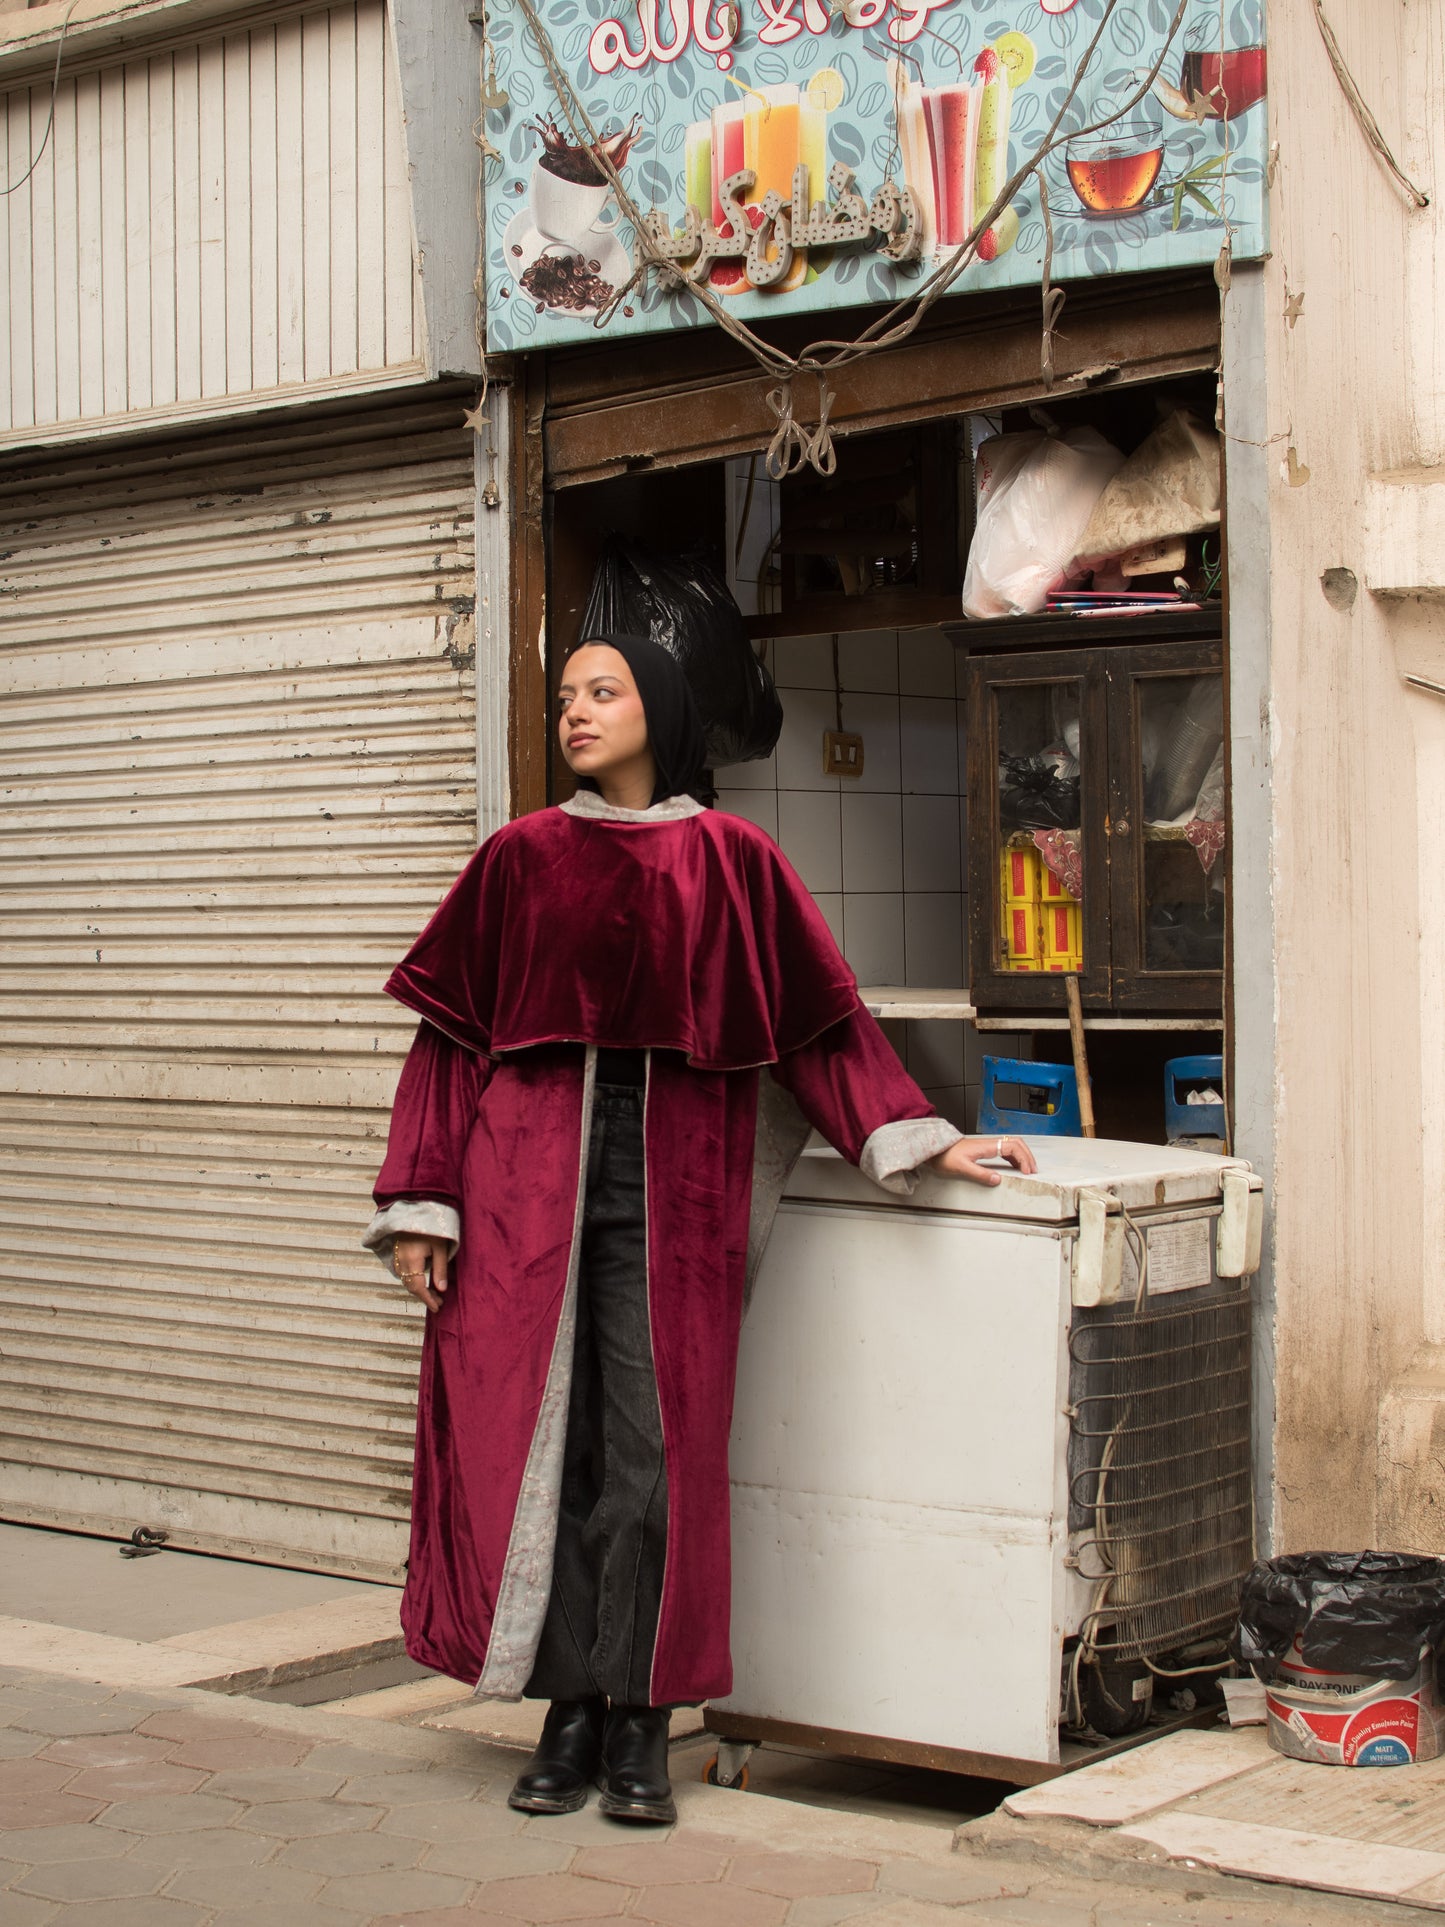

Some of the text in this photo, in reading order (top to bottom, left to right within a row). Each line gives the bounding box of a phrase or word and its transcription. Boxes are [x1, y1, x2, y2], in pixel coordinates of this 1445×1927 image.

[746, 160, 924, 286] رمضان
[1351, 1726, 1372, 1744] Quality
[1370, 1719, 1399, 1730] Emulsion
[1399, 1719, 1415, 1730] Paint
[1369, 1753, 1398, 1762] INTERIOR
[1375, 1745, 1394, 1753] MATT
